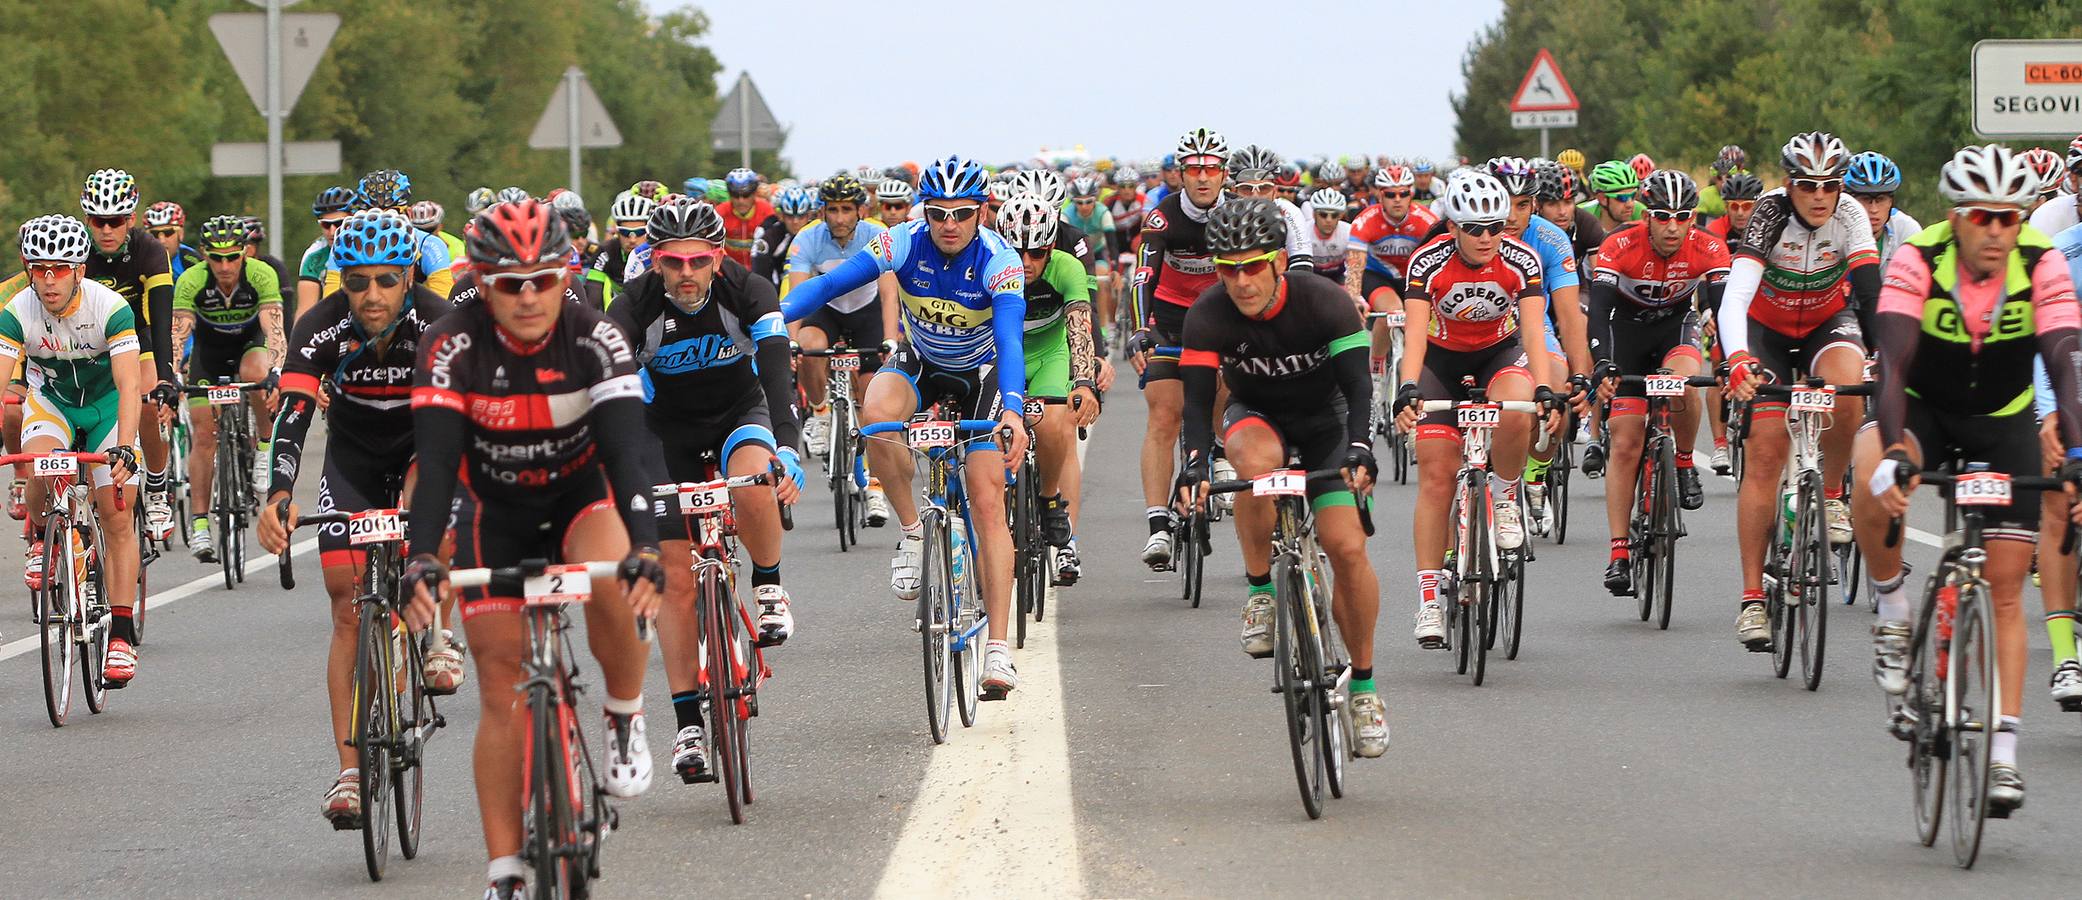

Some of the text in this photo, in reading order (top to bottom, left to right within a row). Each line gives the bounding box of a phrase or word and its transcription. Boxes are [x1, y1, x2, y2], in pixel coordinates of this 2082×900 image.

[1993, 96, 2079, 113] SEGOVI
[998, 279, 1021, 292] MG
[931, 300, 956, 312] GIN
[1440, 286, 1511, 315] GLOBEROS
[918, 306, 968, 328] MG
[832, 358, 859, 368] 1056
[1647, 379, 1683, 391] 1824
[208, 388, 238, 400] 1846
[1792, 392, 1833, 406] 1893
[1459, 410, 1497, 422] 1617
[910, 428, 953, 442] 1559
[39, 458, 71, 471] 865
[1267, 475, 1288, 488] 11
[1956, 479, 2007, 496] 1833
[690, 491, 715, 507] 65
[350, 516, 397, 536] 2061
[550, 575, 564, 593] 2
